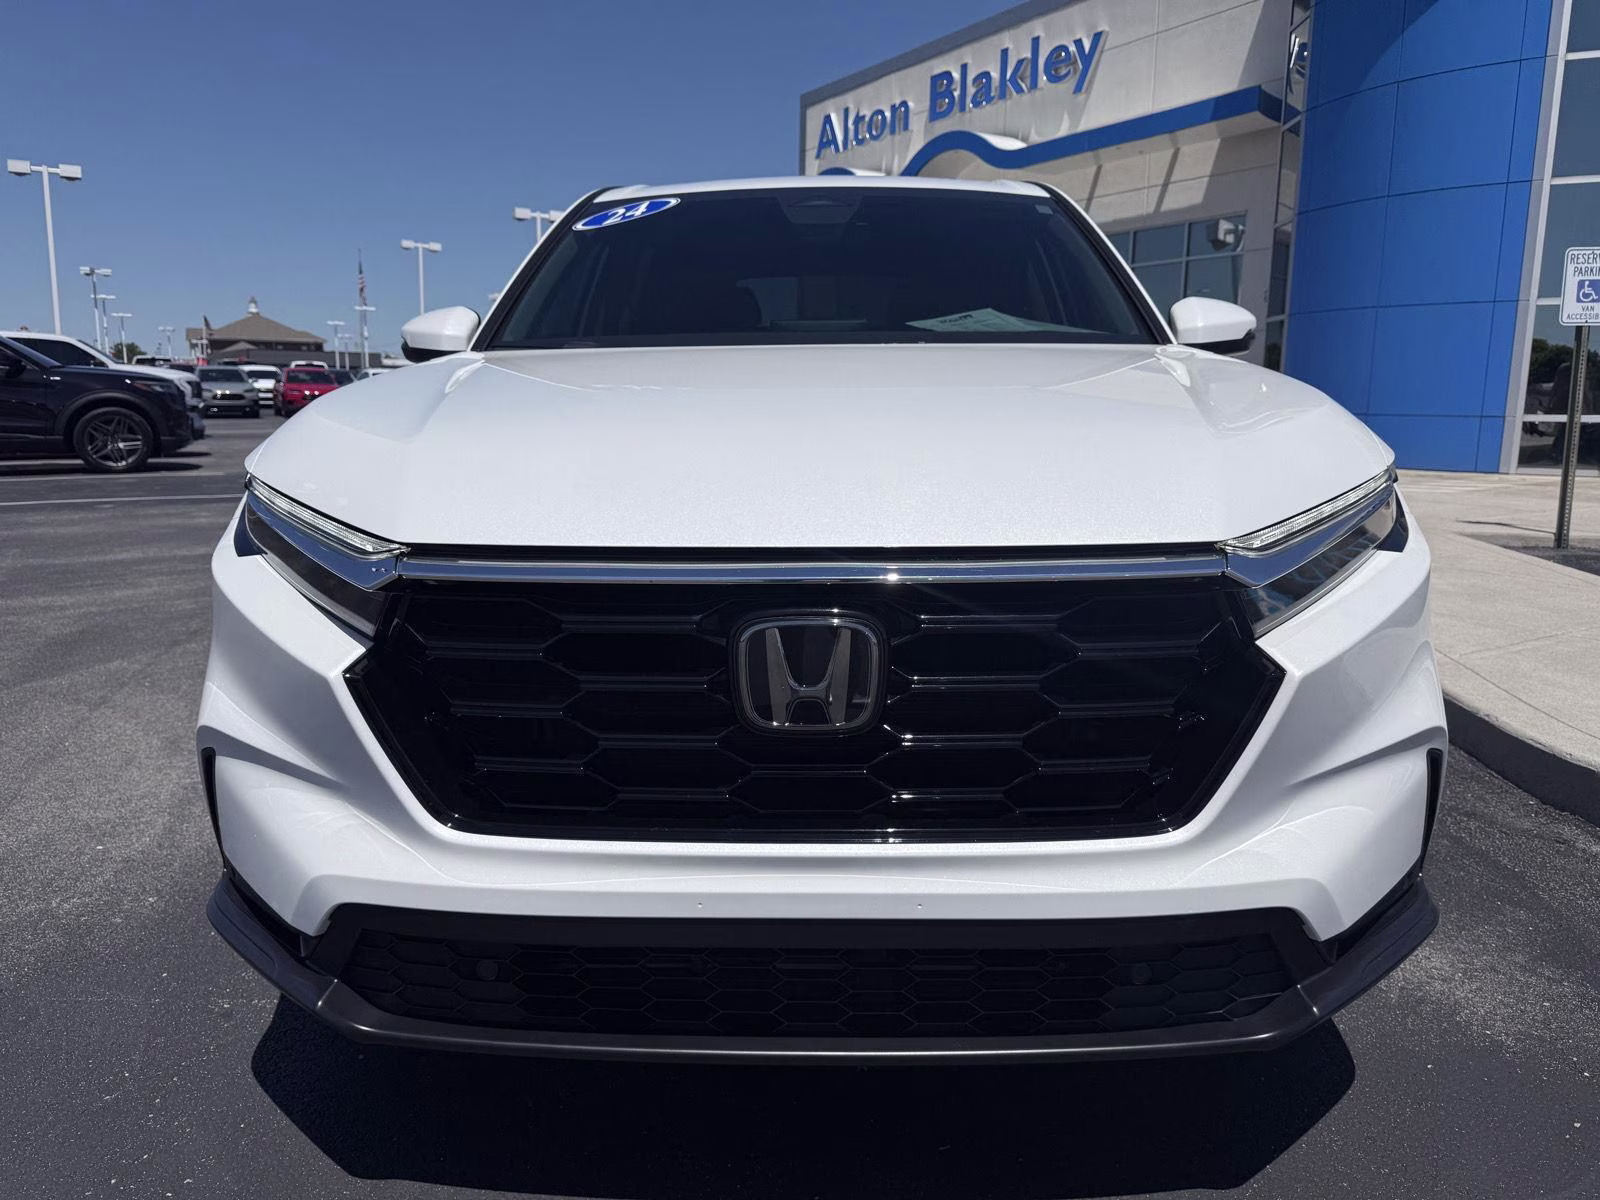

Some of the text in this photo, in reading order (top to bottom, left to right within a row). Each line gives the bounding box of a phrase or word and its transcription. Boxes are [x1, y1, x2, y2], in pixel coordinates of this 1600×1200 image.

[815, 30, 1105, 159] Alton Blakley
[601, 200, 649, 226] 24
[1569, 252, 1600, 265] RESER
